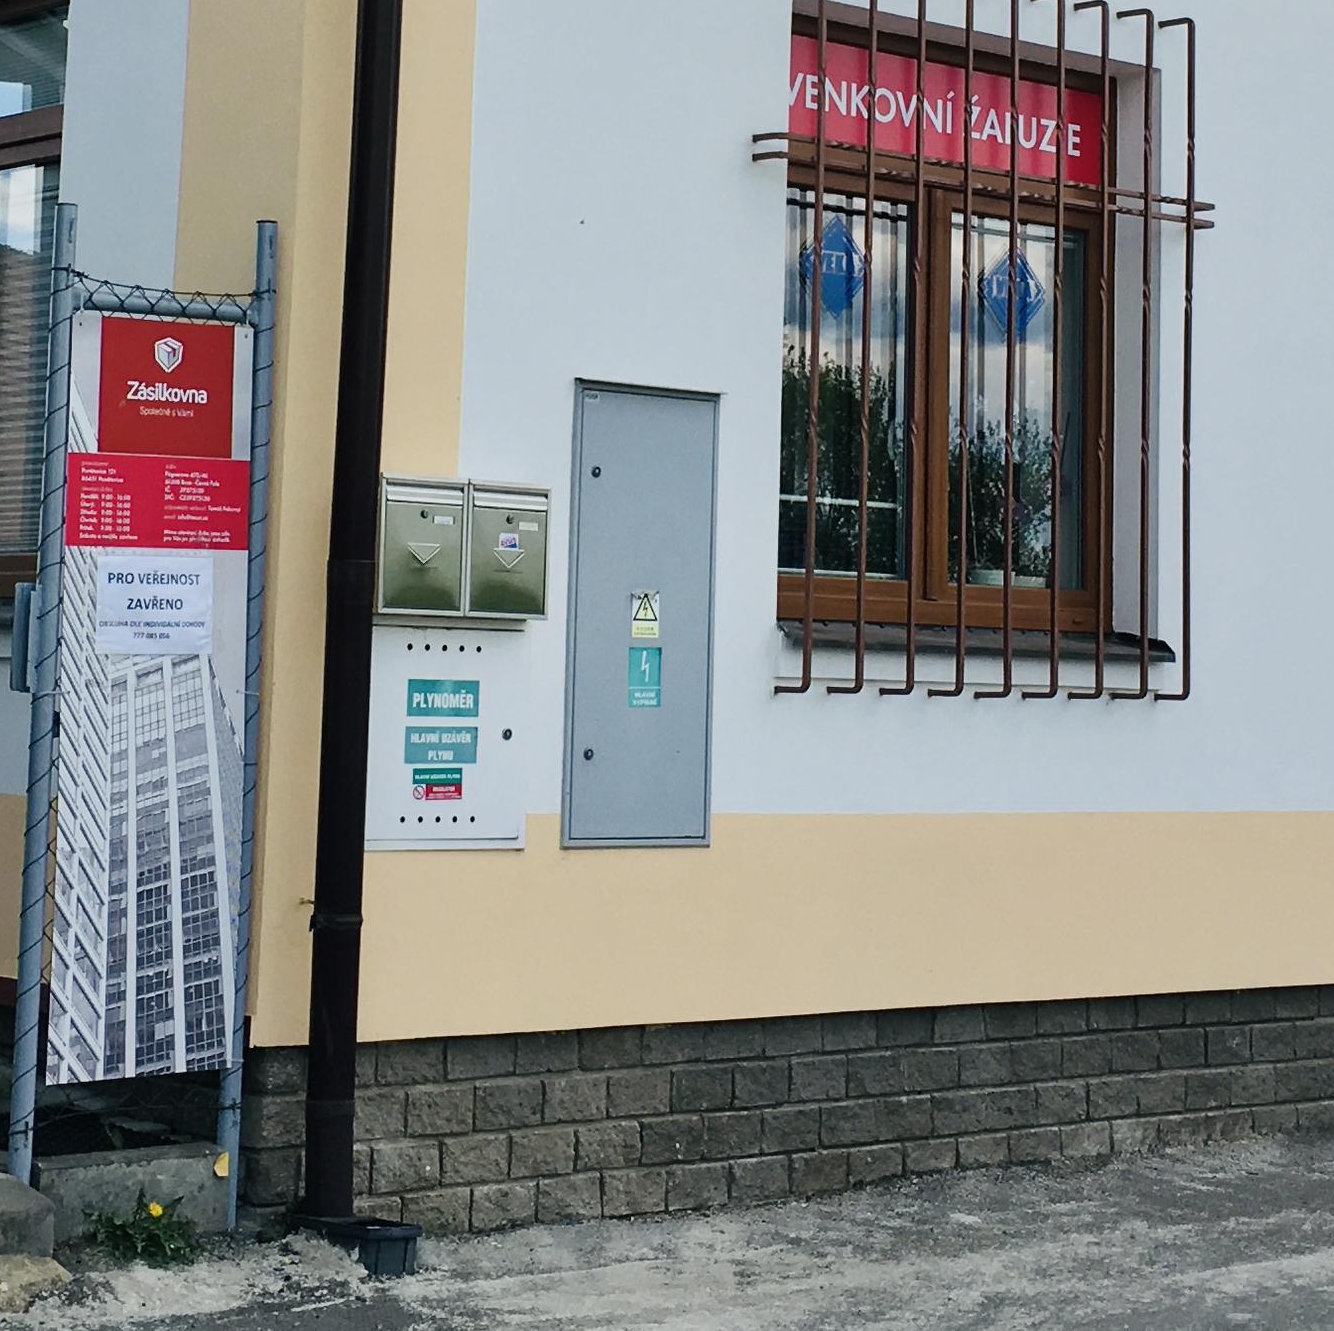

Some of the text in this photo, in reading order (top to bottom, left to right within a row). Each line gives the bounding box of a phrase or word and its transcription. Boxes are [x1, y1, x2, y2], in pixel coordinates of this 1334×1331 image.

[788, 72, 1081, 157] VENKOVNÍ ŽALUZE
[126, 380, 208, 404] Zásilkovna
[107, 570, 200, 585] PRO VEŘEJNOST
[127, 595, 183, 610] ZAVŘENO
[412, 690, 474, 709] PLYNOMĚR
[410, 730, 472, 744] HLAVNÍ UZÁVĚR
[427, 750, 454, 761] PLYNU
